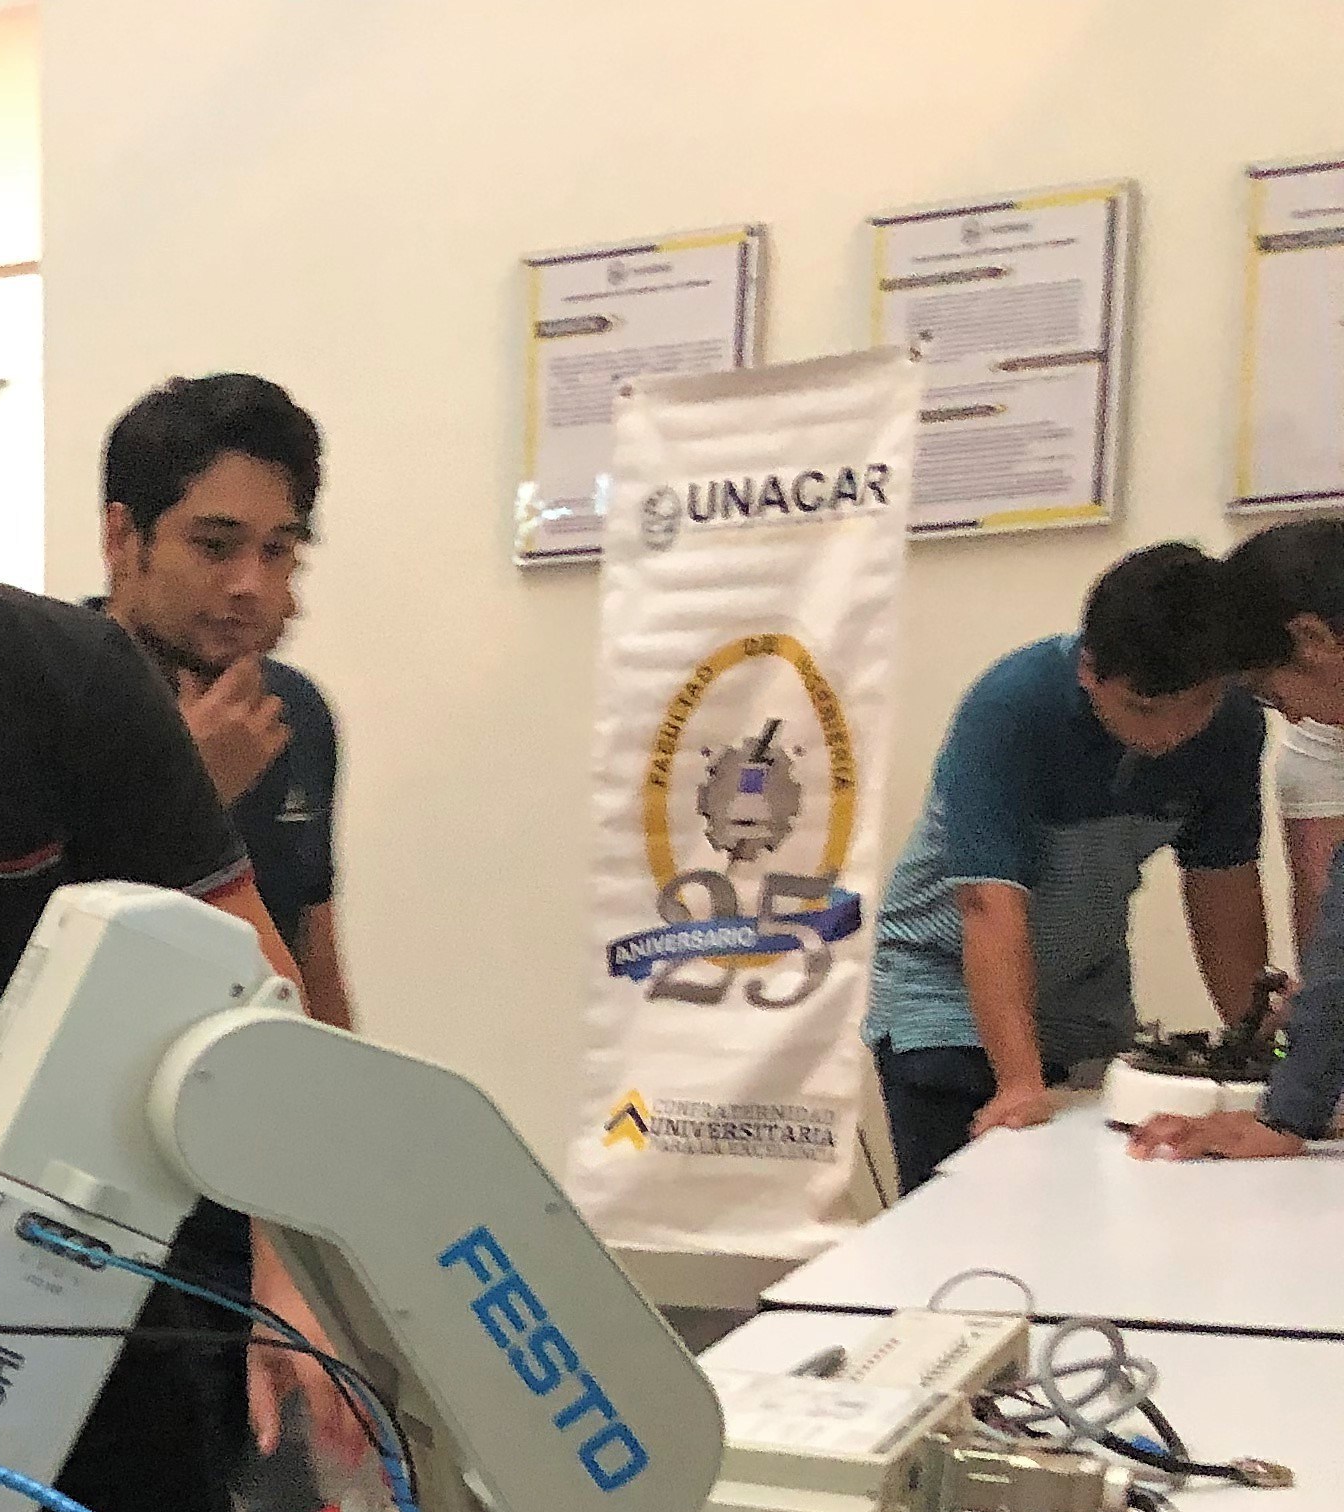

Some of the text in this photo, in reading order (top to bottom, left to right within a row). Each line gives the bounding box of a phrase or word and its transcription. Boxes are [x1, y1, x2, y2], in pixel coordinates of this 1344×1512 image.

[686, 463, 891, 523] UNACAR
[614, 926, 758, 965] ANIVERSARIO
[646, 869, 834, 1009] 25
[649, 1116, 836, 1147] UNIVERSITARIA
[435, 1223, 650, 1492] FESTO
